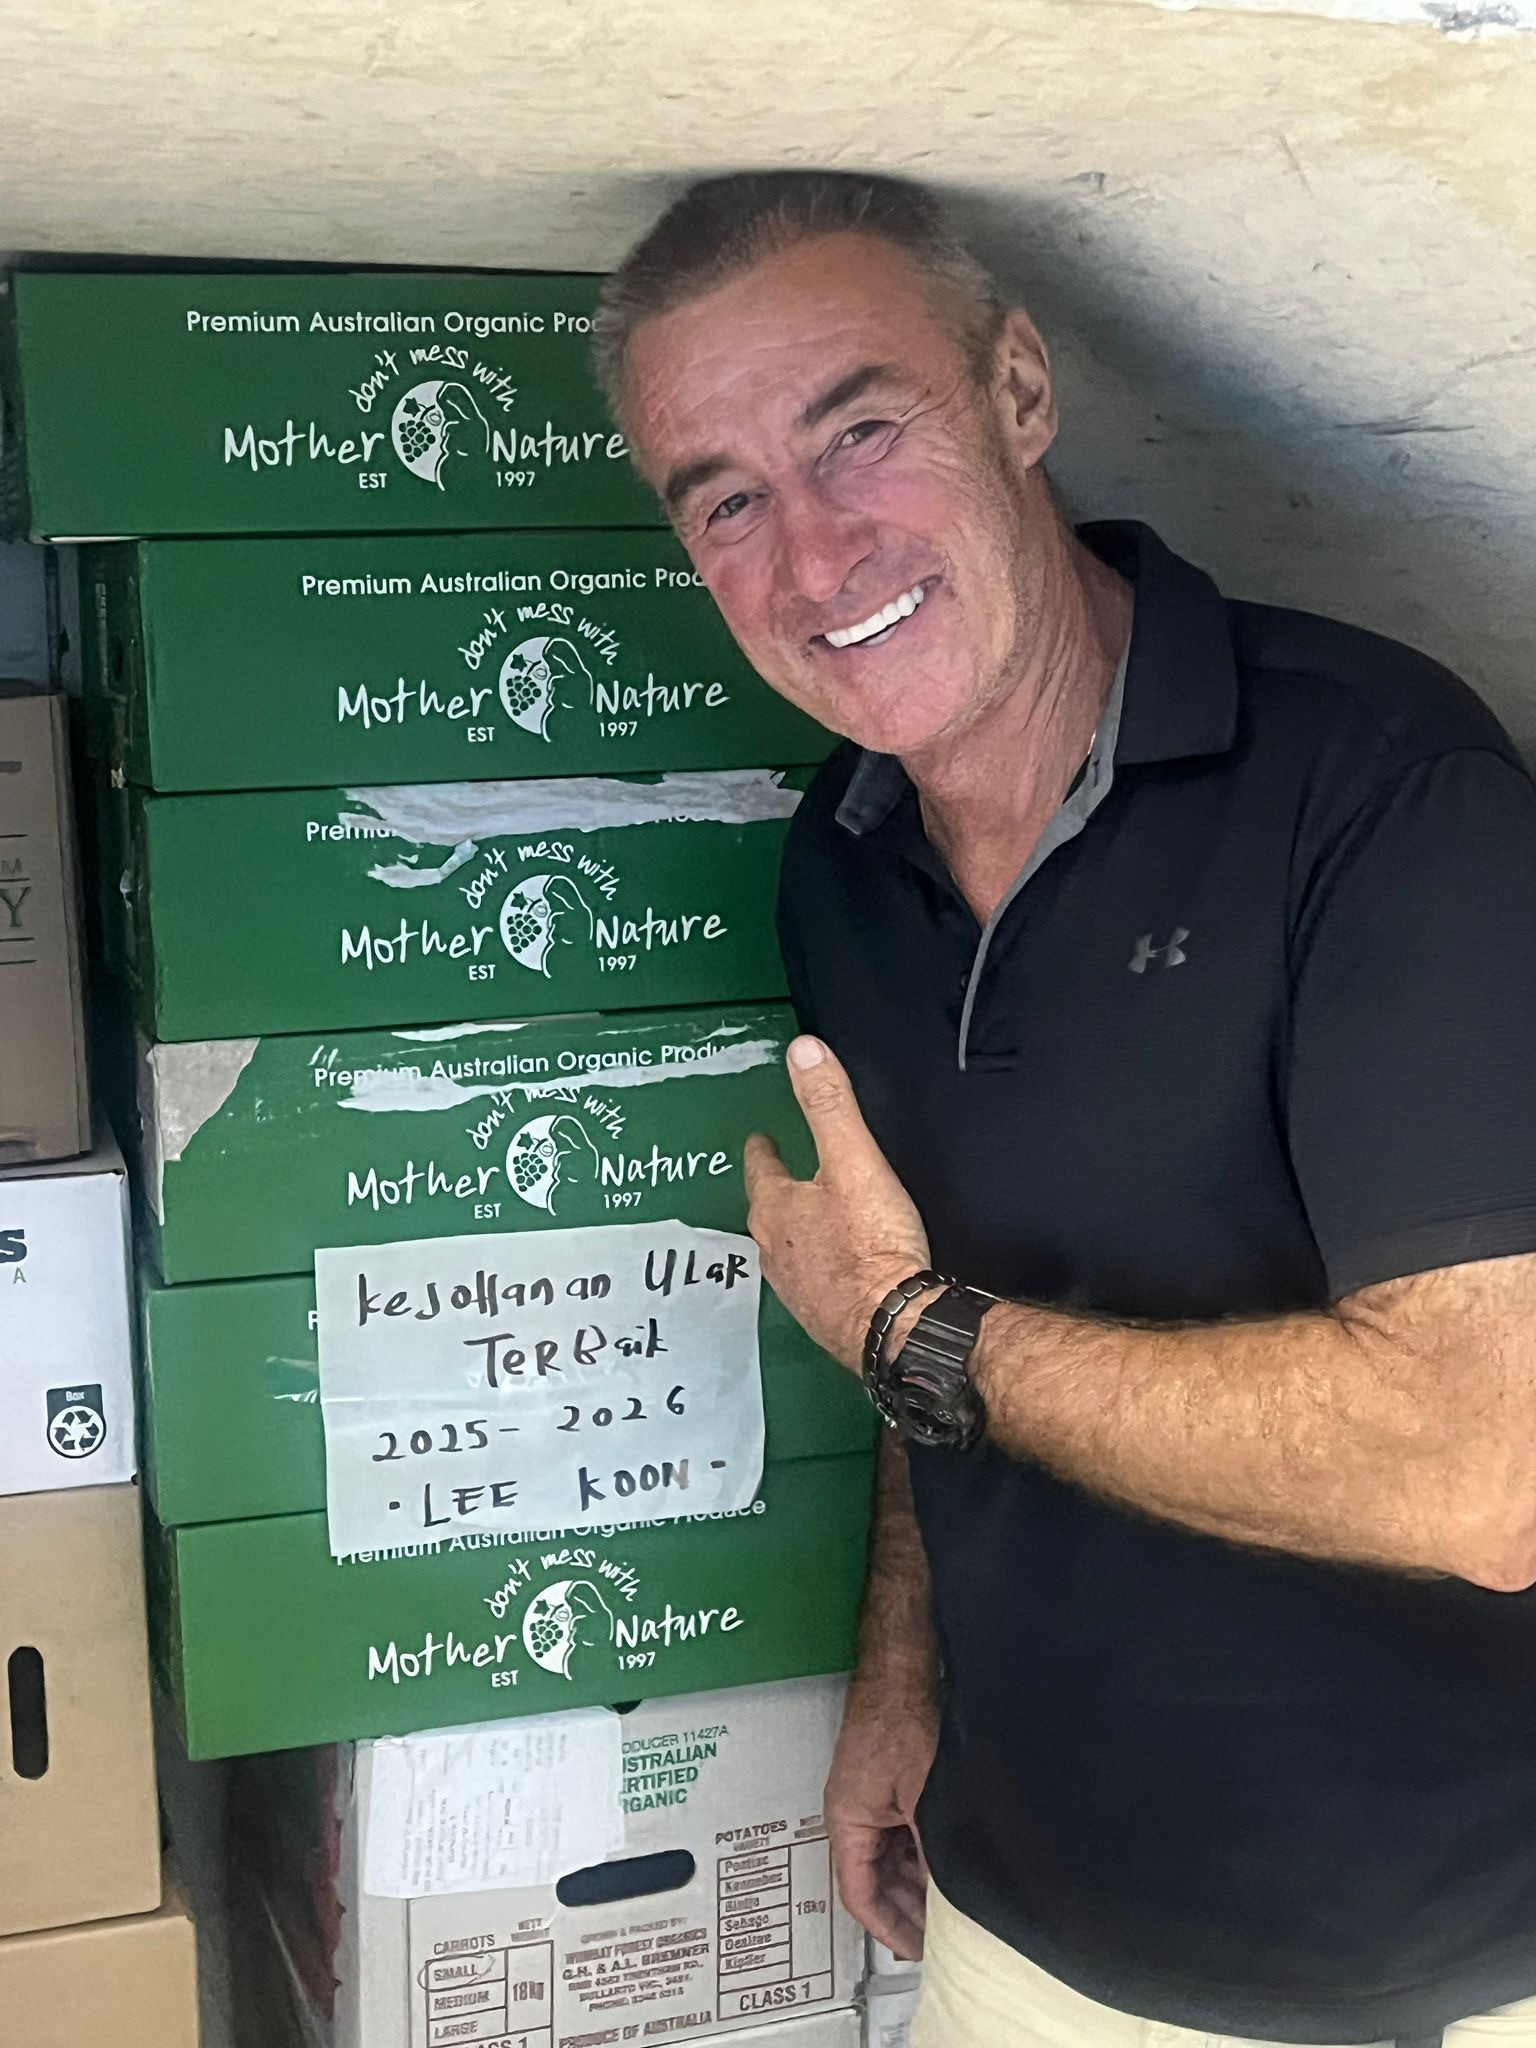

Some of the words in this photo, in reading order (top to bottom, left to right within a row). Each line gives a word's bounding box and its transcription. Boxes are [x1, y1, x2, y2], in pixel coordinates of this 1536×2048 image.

[187, 310, 300, 332] Premium
[309, 311, 435, 333] Australian
[444, 311, 545, 338] Organic
[348, 349, 399, 414] don't
[409, 344, 469, 369] mess
[472, 365, 518, 413] with
[224, 419, 385, 472] Mother
[492, 420, 630, 466] Nature
[358, 472, 387, 489] EST
[496, 471, 536, 487] 1997
[302, 574, 412, 596] Premium
[420, 571, 542, 594] Australian
[549, 569, 646, 595] Organic
[457, 607, 508, 672] don't
[516, 602, 574, 625] mess
[577, 620, 620, 667] with
[338, 677, 495, 731] Mother
[596, 672, 730, 717] Nature
[467, 726, 495, 743] EST
[599, 721, 638, 737] 1997
[464, 846, 507, 911] don't
[517, 840, 575, 863] mess
[576, 854, 619, 903] with
[341, 918, 495, 972] Mother
[595, 907, 728, 951] Nature
[468, 964, 496, 981] EST
[598, 954, 637, 972] 1997
[430, 1054, 548, 1081] Australian
[557, 1047, 653, 1073] Organic
[465, 1090, 515, 1150] don't
[583, 1094, 627, 1140] with
[348, 1160, 501, 1213] Mother
[601, 1144, 733, 1187] Nature
[474, 1202, 501, 1219] EST
[603, 1191, 642, 1209] 1997
[556, 1385, 685, 1432] 2026
[423, 1480, 518, 1528] LEE
[483, 1558, 530, 1621] don't
[540, 1548, 596, 1570] mess
[598, 1559, 641, 1604] with
[368, 1632, 519, 1687] Mother
[615, 1604, 744, 1649] Nature
[491, 1669, 519, 1688] EST
[618, 1651, 656, 1670] 1997
[715, 1819, 788, 1845] POTATOES
[434, 1934, 496, 1955] CARROTS
[434, 1963, 478, 1982] SMALL
[434, 1990, 490, 2011] MEDIUM
[739, 1984, 796, 2012] CLASS
[801, 1981, 811, 2000] 1
[434, 2020, 478, 2039] LARGE
